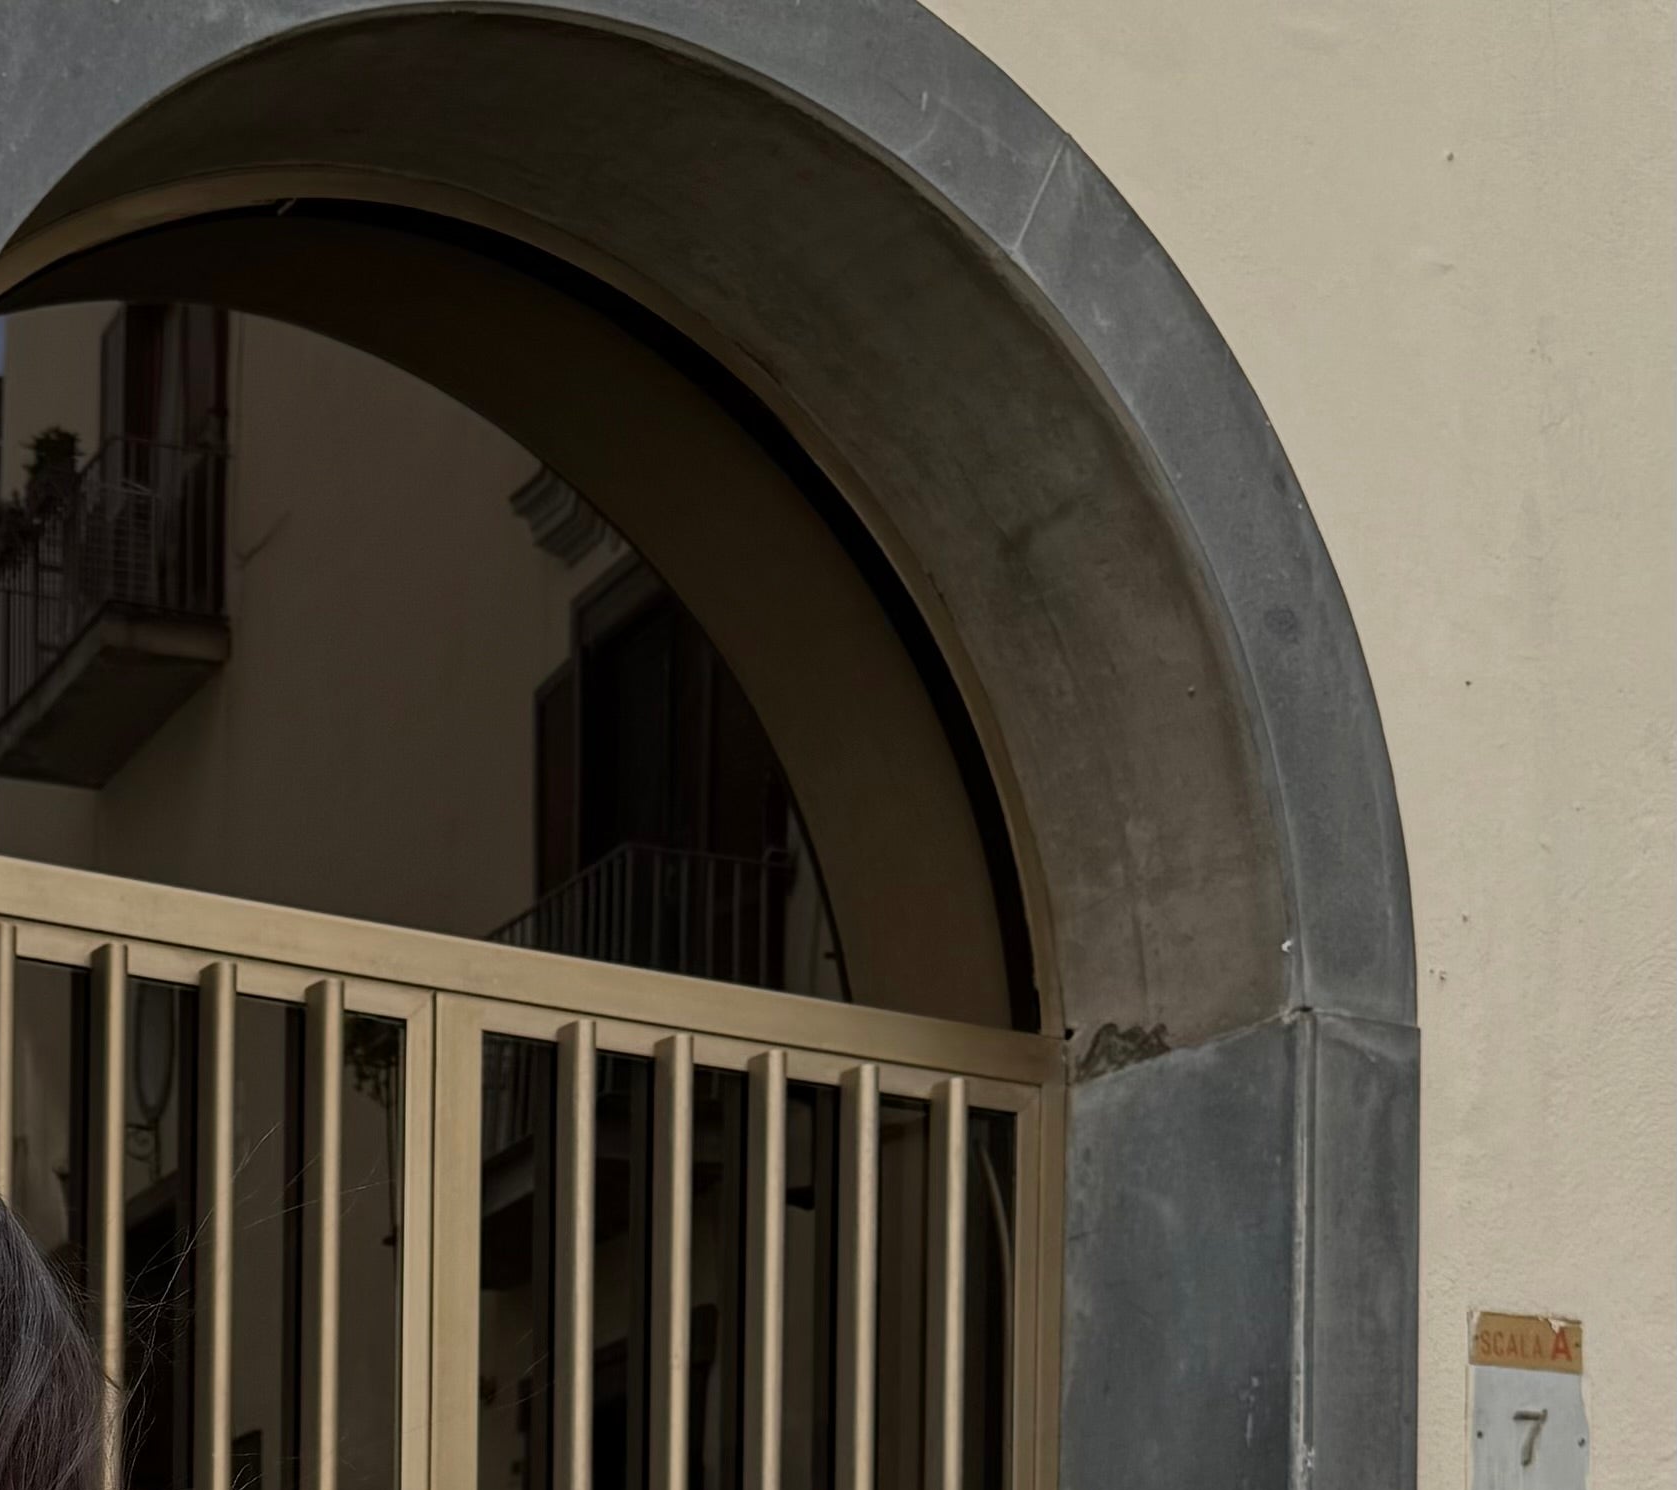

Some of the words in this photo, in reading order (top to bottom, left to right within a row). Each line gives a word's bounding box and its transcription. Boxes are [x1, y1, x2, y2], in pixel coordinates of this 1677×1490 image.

[1479, 1330, 1543, 1359] SCALA
[1551, 1327, 1573, 1362] A
[1512, 1408, 1549, 1467] 7
